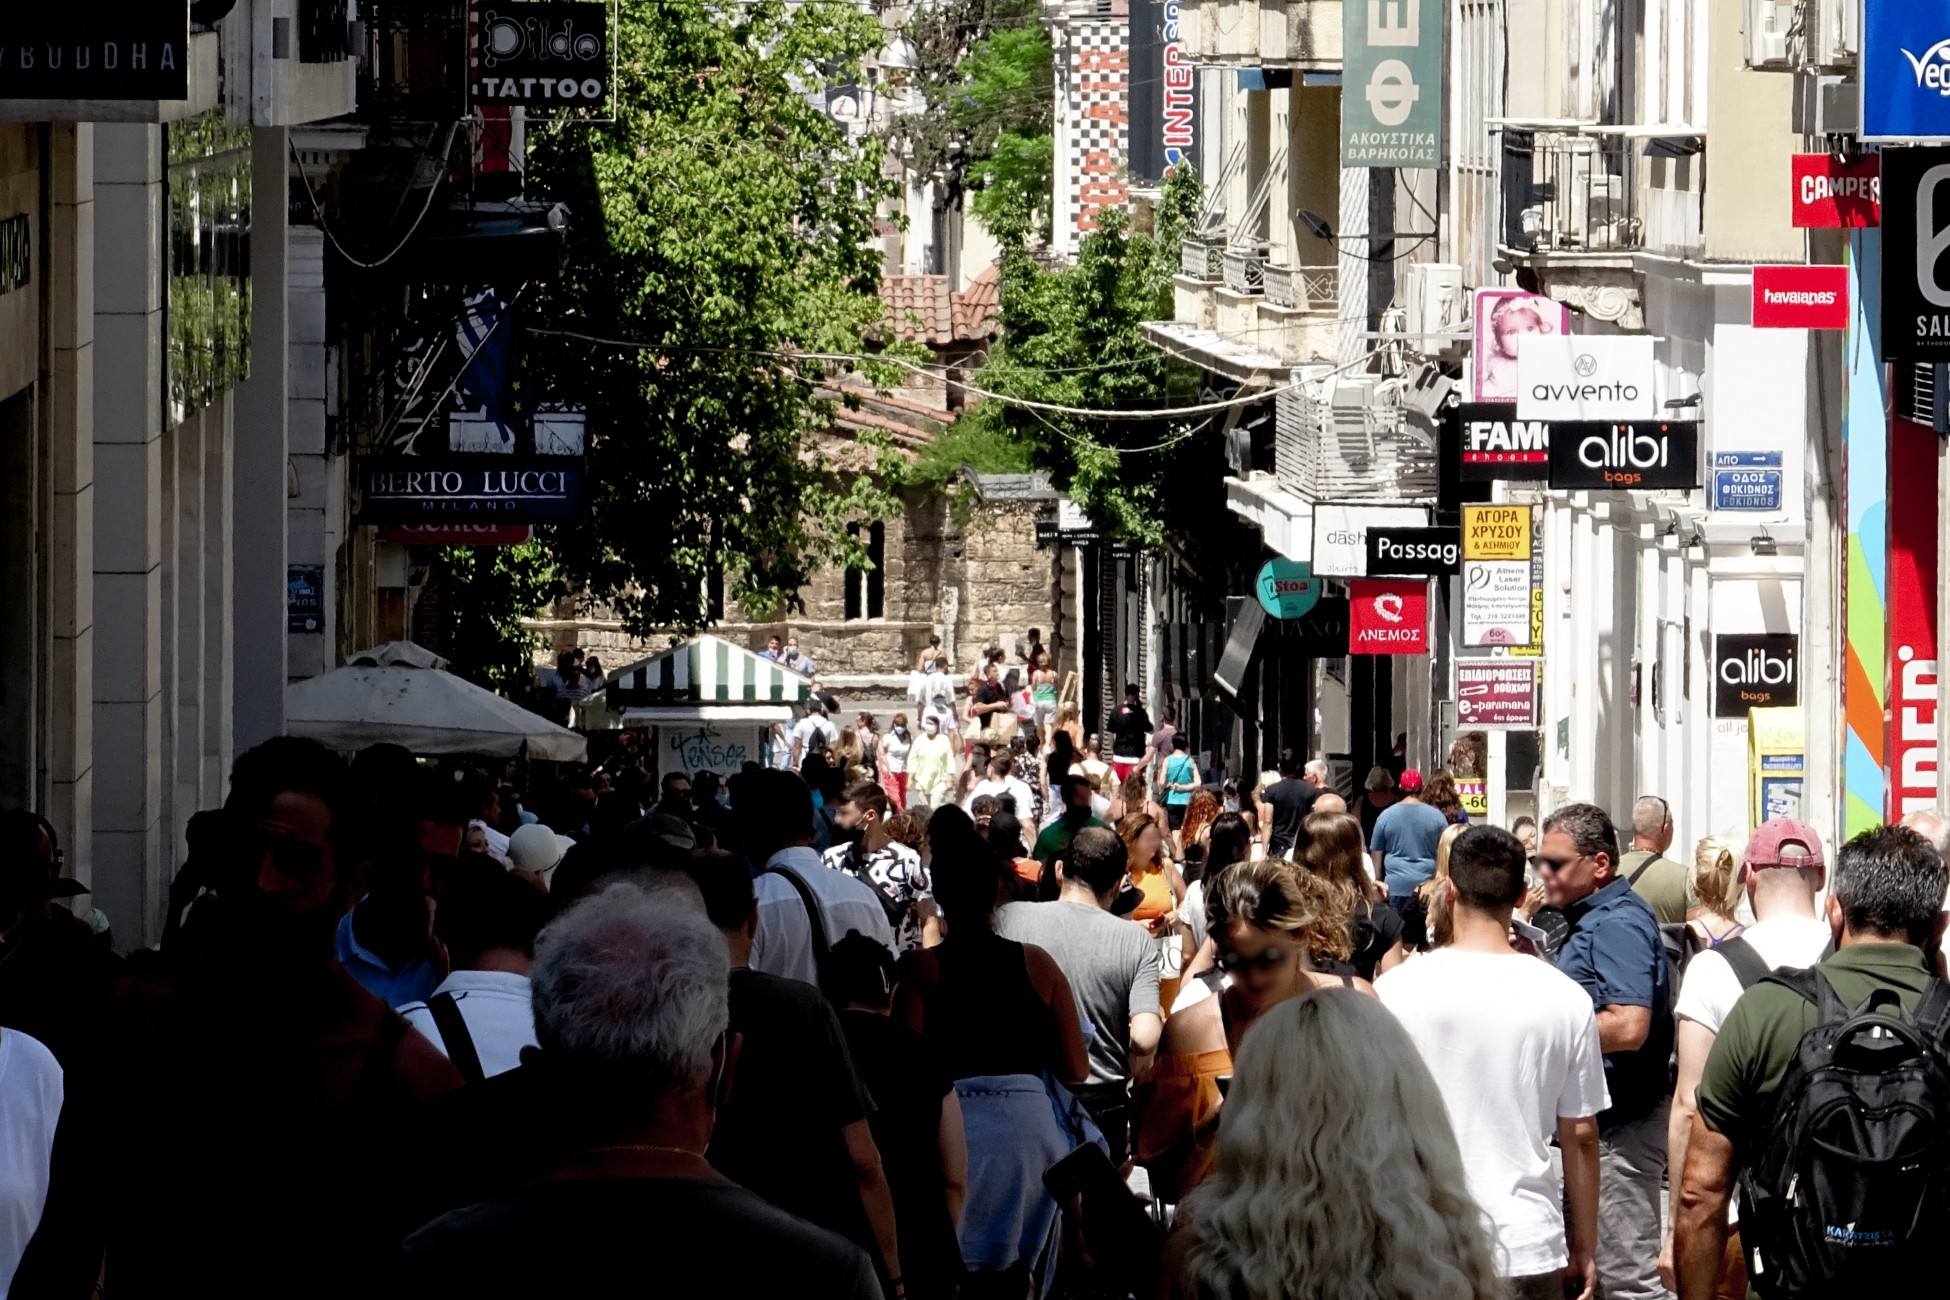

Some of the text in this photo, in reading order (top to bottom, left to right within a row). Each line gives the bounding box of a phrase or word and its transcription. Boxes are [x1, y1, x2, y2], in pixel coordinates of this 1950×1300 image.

[481, 77, 602, 99] TATTOO
[1349, 132, 1435, 146] ΑΚΟΥΣΤΙΚΑ
[1348, 146, 1434, 160] ΒΑΡΗΚΟΪΑΣ
[1801, 175, 1880, 205] CAMPER
[1532, 380, 1639, 402] avvento
[1579, 424, 1669, 468] alibi
[1718, 455, 1739, 465] ΑΠΟ
[371, 471, 566, 494] BERTO LUCCI
[1604, 470, 1642, 484] bags
[1732, 473, 1766, 483] ΟΔΟΣ
[1722, 484, 1775, 495] ΦΩΚΙΩΝΟΣ
[422, 501, 517, 511] MILANO
[1722, 497, 1775, 506] FOKIONOS
[1476, 510, 1519, 524] ΑΓΟΡΑ
[1471, 525, 1522, 539] ΧΡΥΣΟΥ
[1474, 541, 1520, 550] & ΑΣΗΜΙΟΥ
[1496, 567, 1525, 575] Athens
[1494, 584, 1528, 592] Solution
[1721, 648, 1792, 684] alibi
[1741, 690, 1771, 703] bags
[1454, 783, 1487, 795] SAL
